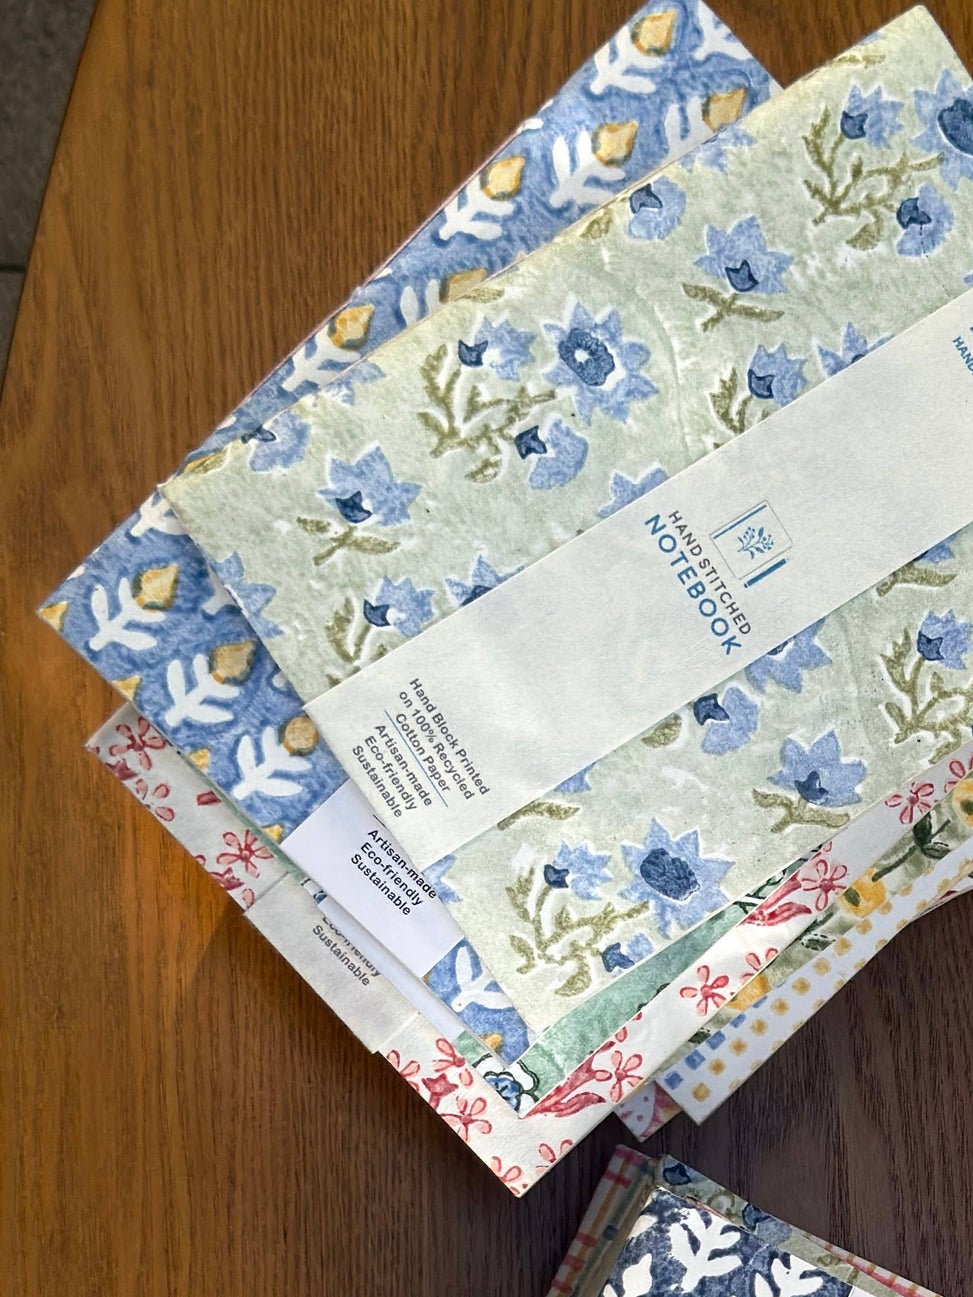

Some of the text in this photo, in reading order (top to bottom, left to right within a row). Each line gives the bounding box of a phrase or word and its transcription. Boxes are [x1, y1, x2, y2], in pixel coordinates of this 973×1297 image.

[644, 514, 742, 655] NOTEBOOK
[668, 510, 752, 635] HAND STITCHED
[364, 735, 417, 811] Eco-friendly
[375, 725, 432, 806] Artisan-made
[395, 713, 451, 792] Cotton Paper
[399, 691, 475, 800] on 100% Recycled
[409, 678, 490, 795] Hand Block Printed
[353, 745, 403, 818] Sustainable
[351, 854, 411, 916] Sustainable
[360, 842, 423, 907] Eco-friendly
[367, 829, 437, 899] Artisan-made
[313, 925, 370, 986] Sustainable
